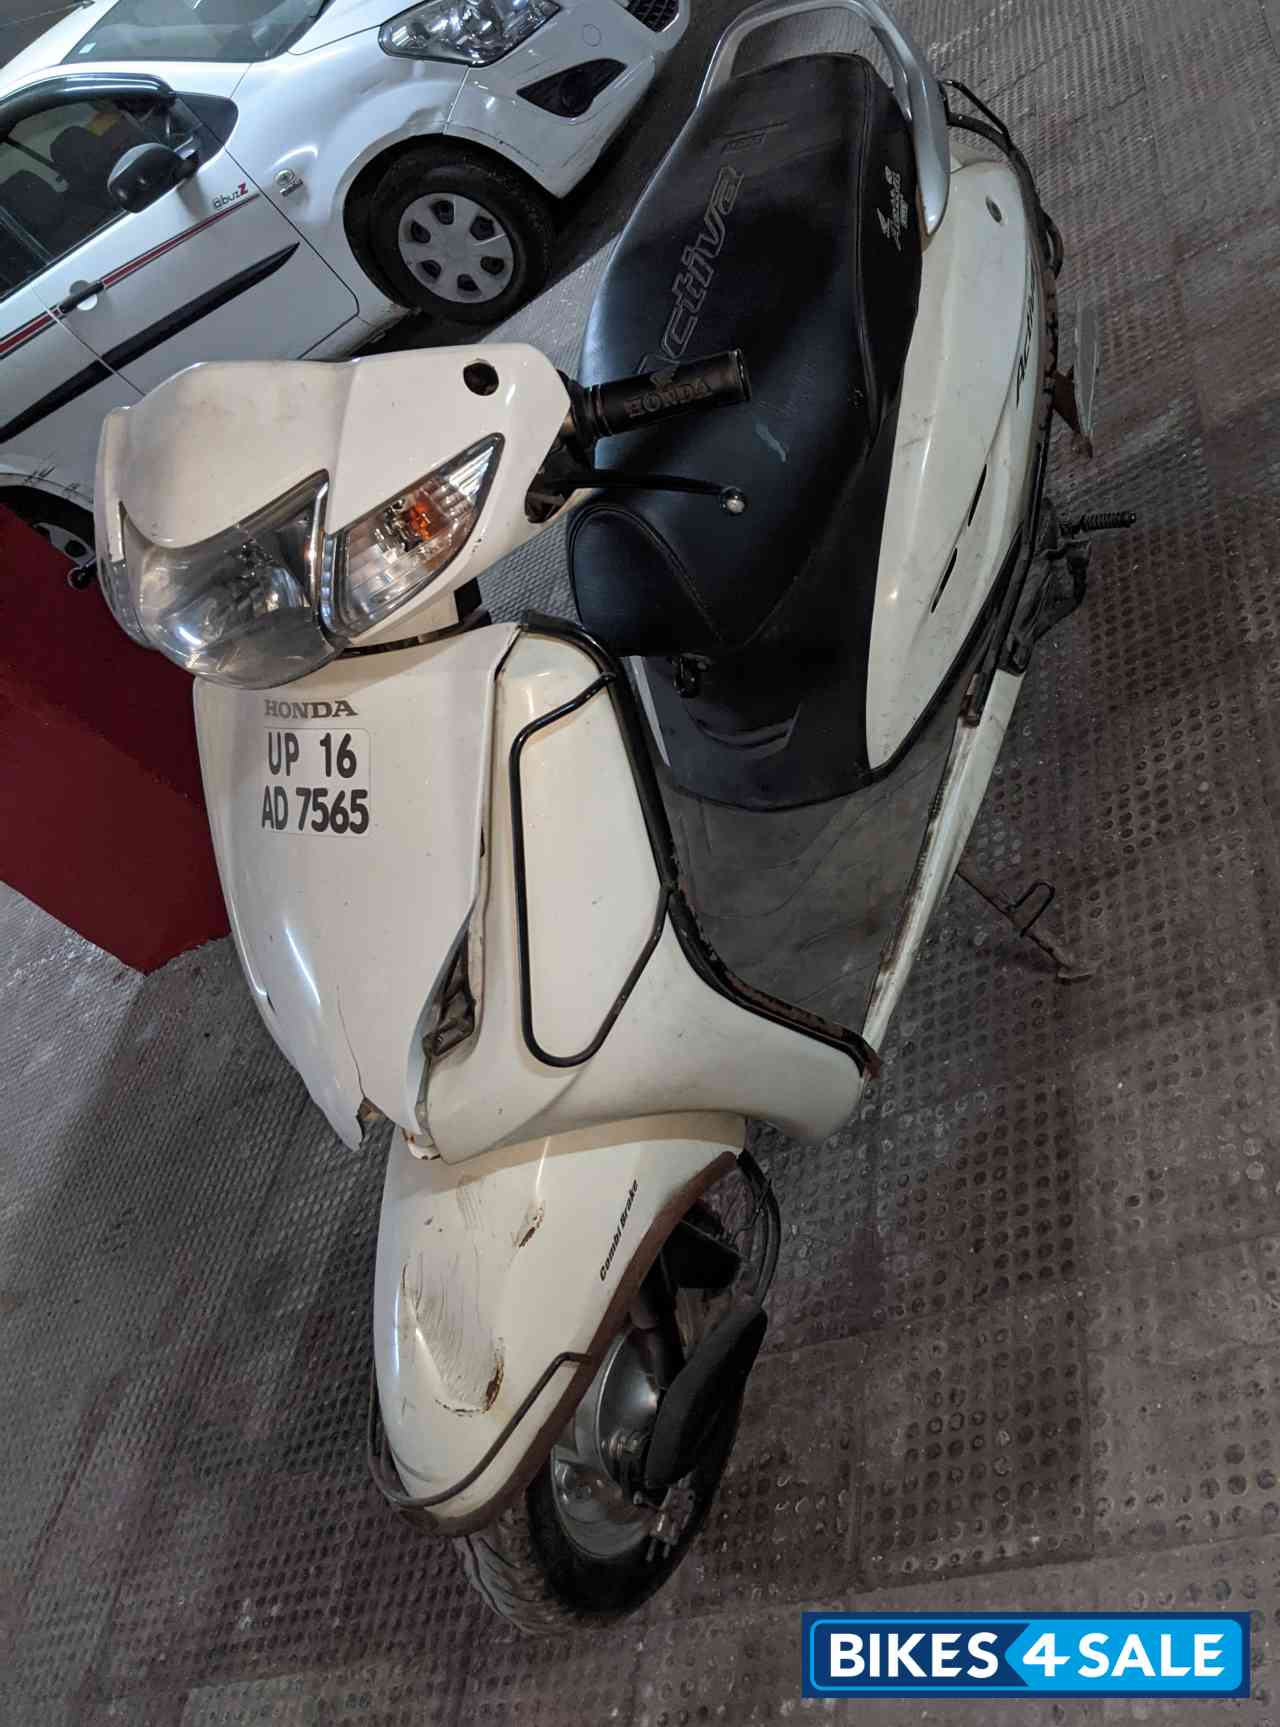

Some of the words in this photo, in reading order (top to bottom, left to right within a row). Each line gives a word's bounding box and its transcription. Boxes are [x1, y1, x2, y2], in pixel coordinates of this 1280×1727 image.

[264, 699, 358, 719] HONDA
[268, 731, 300, 776] UP
[319, 732, 357, 778] 16
[261, 785, 289, 830] AD
[295, 786, 369, 834] 7565
[600, 1226, 622, 1281] Combi
[620, 1179, 638, 1228] Brake
